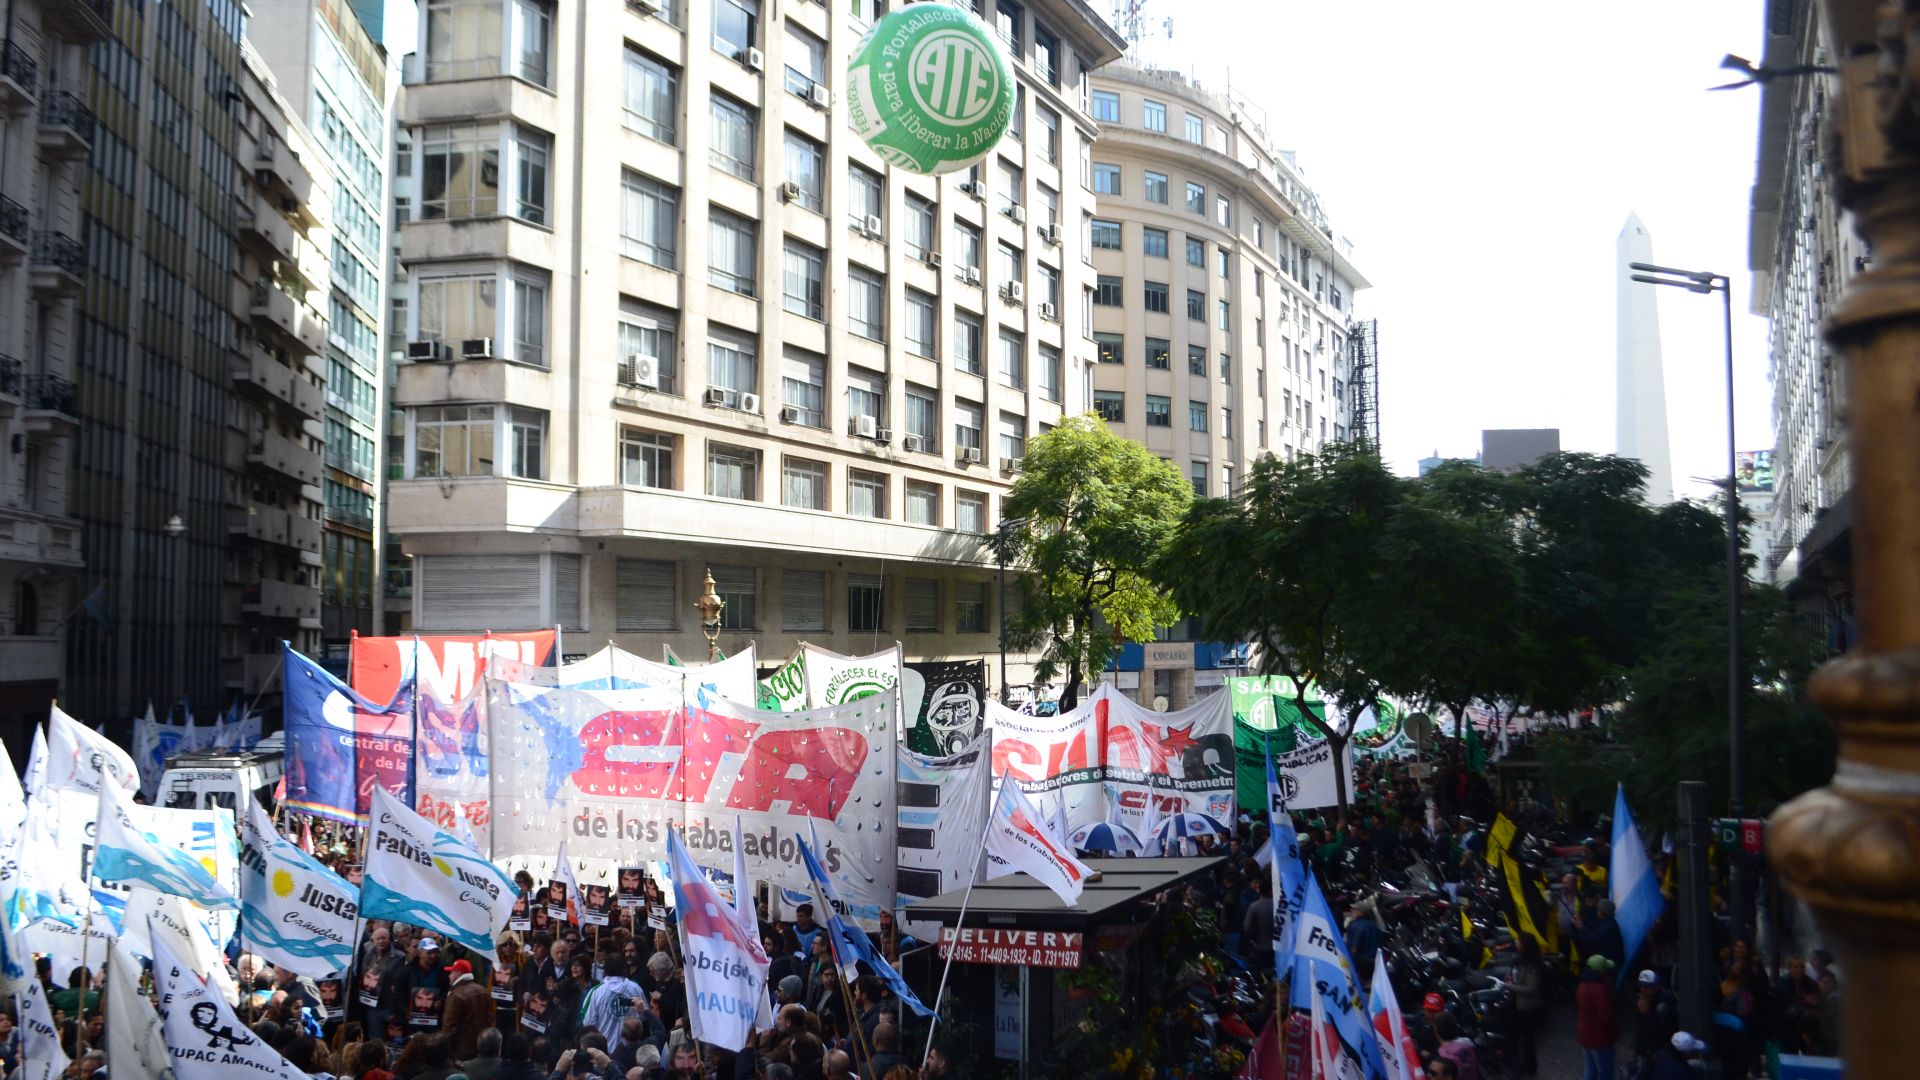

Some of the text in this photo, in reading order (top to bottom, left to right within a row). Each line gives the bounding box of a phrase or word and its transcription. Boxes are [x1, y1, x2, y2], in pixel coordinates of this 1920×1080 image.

[882, 10, 960, 60] Fortalecer
[916, 37, 992, 117] ATE
[878, 71, 904, 113] para
[899, 107, 951, 150] liberar
[954, 133, 969, 150] la
[867, 667, 880, 680] EL
[339, 735, 389, 752] central
[375, 757, 408, 772] de la
[1158, 774, 1172, 786] el
[572, 807, 609, 839] de
[616, 808, 660, 843] los
[1003, 827, 1016, 838] de
[1015, 834, 1028, 846] los
[1722, 828, 1736, 843] D
[1745, 829, 1757, 844] B
[376, 829, 434, 868] Patria
[299, 883, 358, 921] Justa
[42, 922, 77, 936] TUPAC
[943, 928, 1078, 948] DELIVERY
[938, 946, 972, 961] 434-8145
[1316, 980, 1352, 1016] SAN
[168, 1046, 216, 1063] TUPAC
[220, 1053, 276, 1074] AMARU
